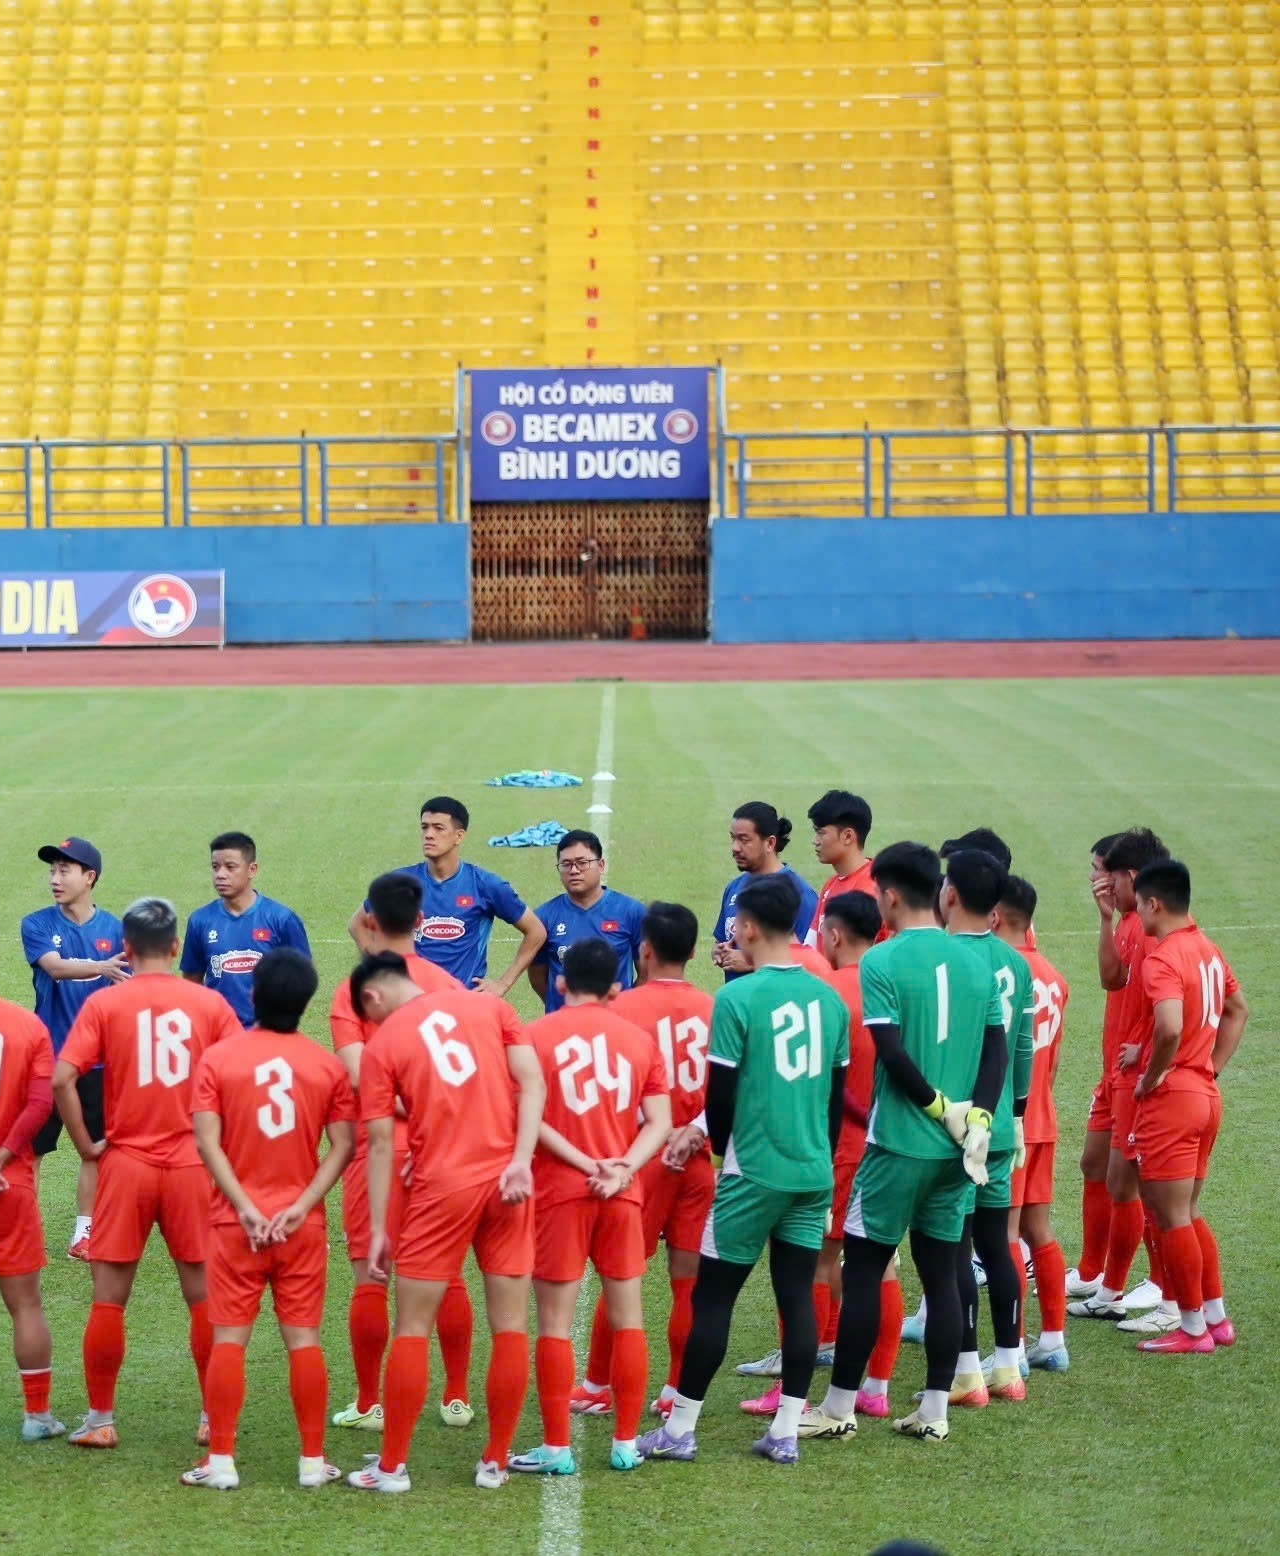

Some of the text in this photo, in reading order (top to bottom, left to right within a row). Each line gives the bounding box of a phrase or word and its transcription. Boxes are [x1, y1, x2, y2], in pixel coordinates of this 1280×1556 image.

[499, 381, 535, 407] HỘI
[630, 380, 674, 404] VIÊN
[523, 413, 658, 443] BECAMEX
[499, 446, 681, 480] BÌNH DƯƠNG
[935, 962, 949, 1044] 1
[1199, 955, 1224, 1029] 10
[136, 1007, 192, 1088] 18
[418, 1010, 478, 1087] 6
[554, 1033, 631, 1115] 24
[656, 1015, 709, 1093] 13
[771, 999, 821, 1082] 21
[255, 1056, 296, 1139] 3
